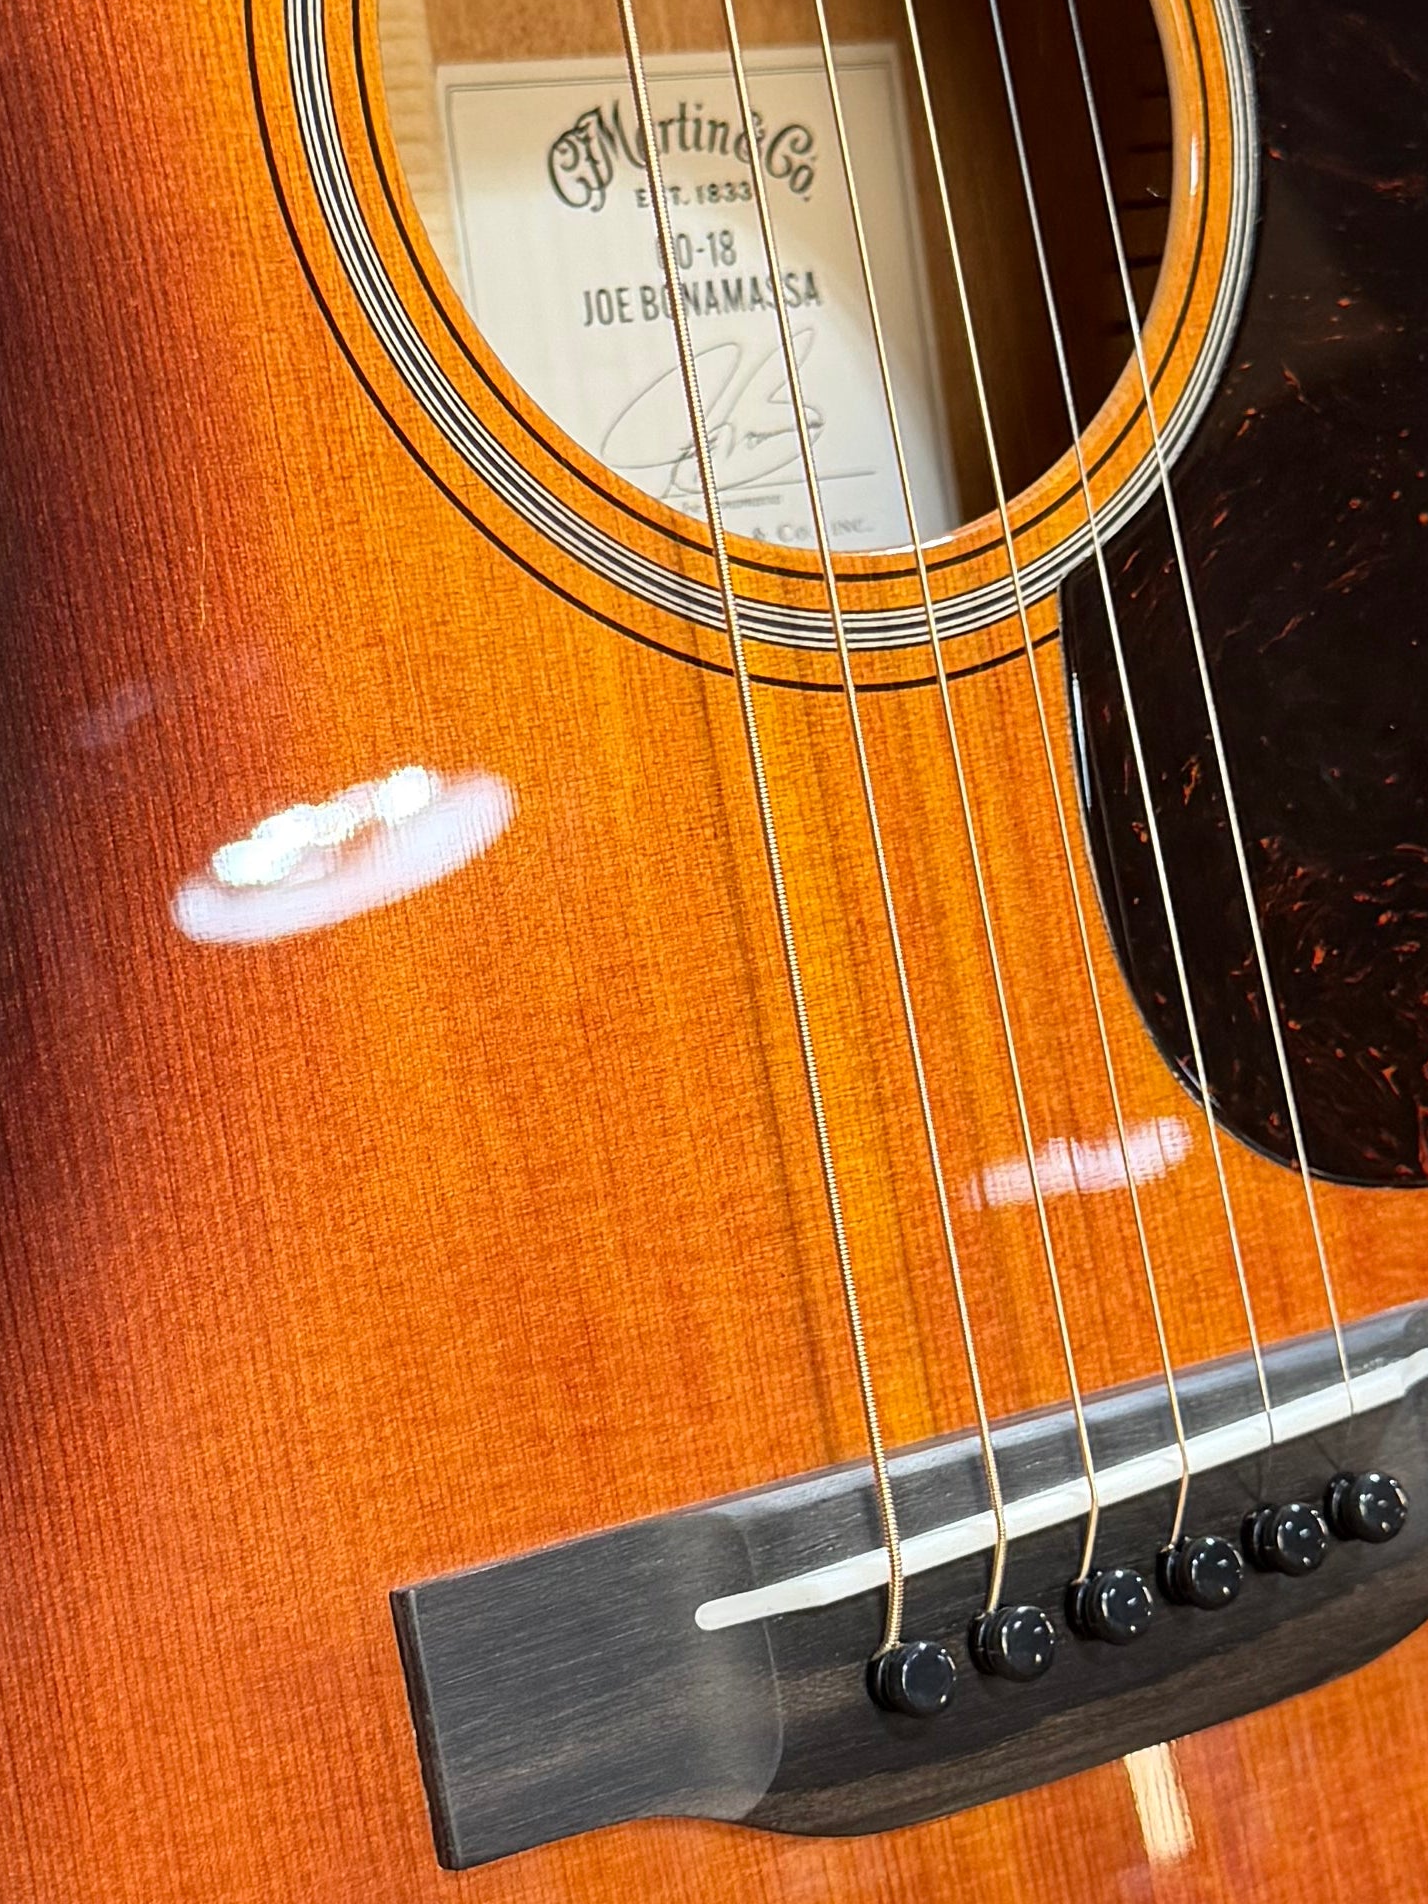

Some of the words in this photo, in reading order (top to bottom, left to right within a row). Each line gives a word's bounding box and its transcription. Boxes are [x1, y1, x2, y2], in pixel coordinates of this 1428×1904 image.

[634, 186, 690, 209] ET.
[696, 180, 753, 205] 1833
[583, 286, 635, 327] JOE
